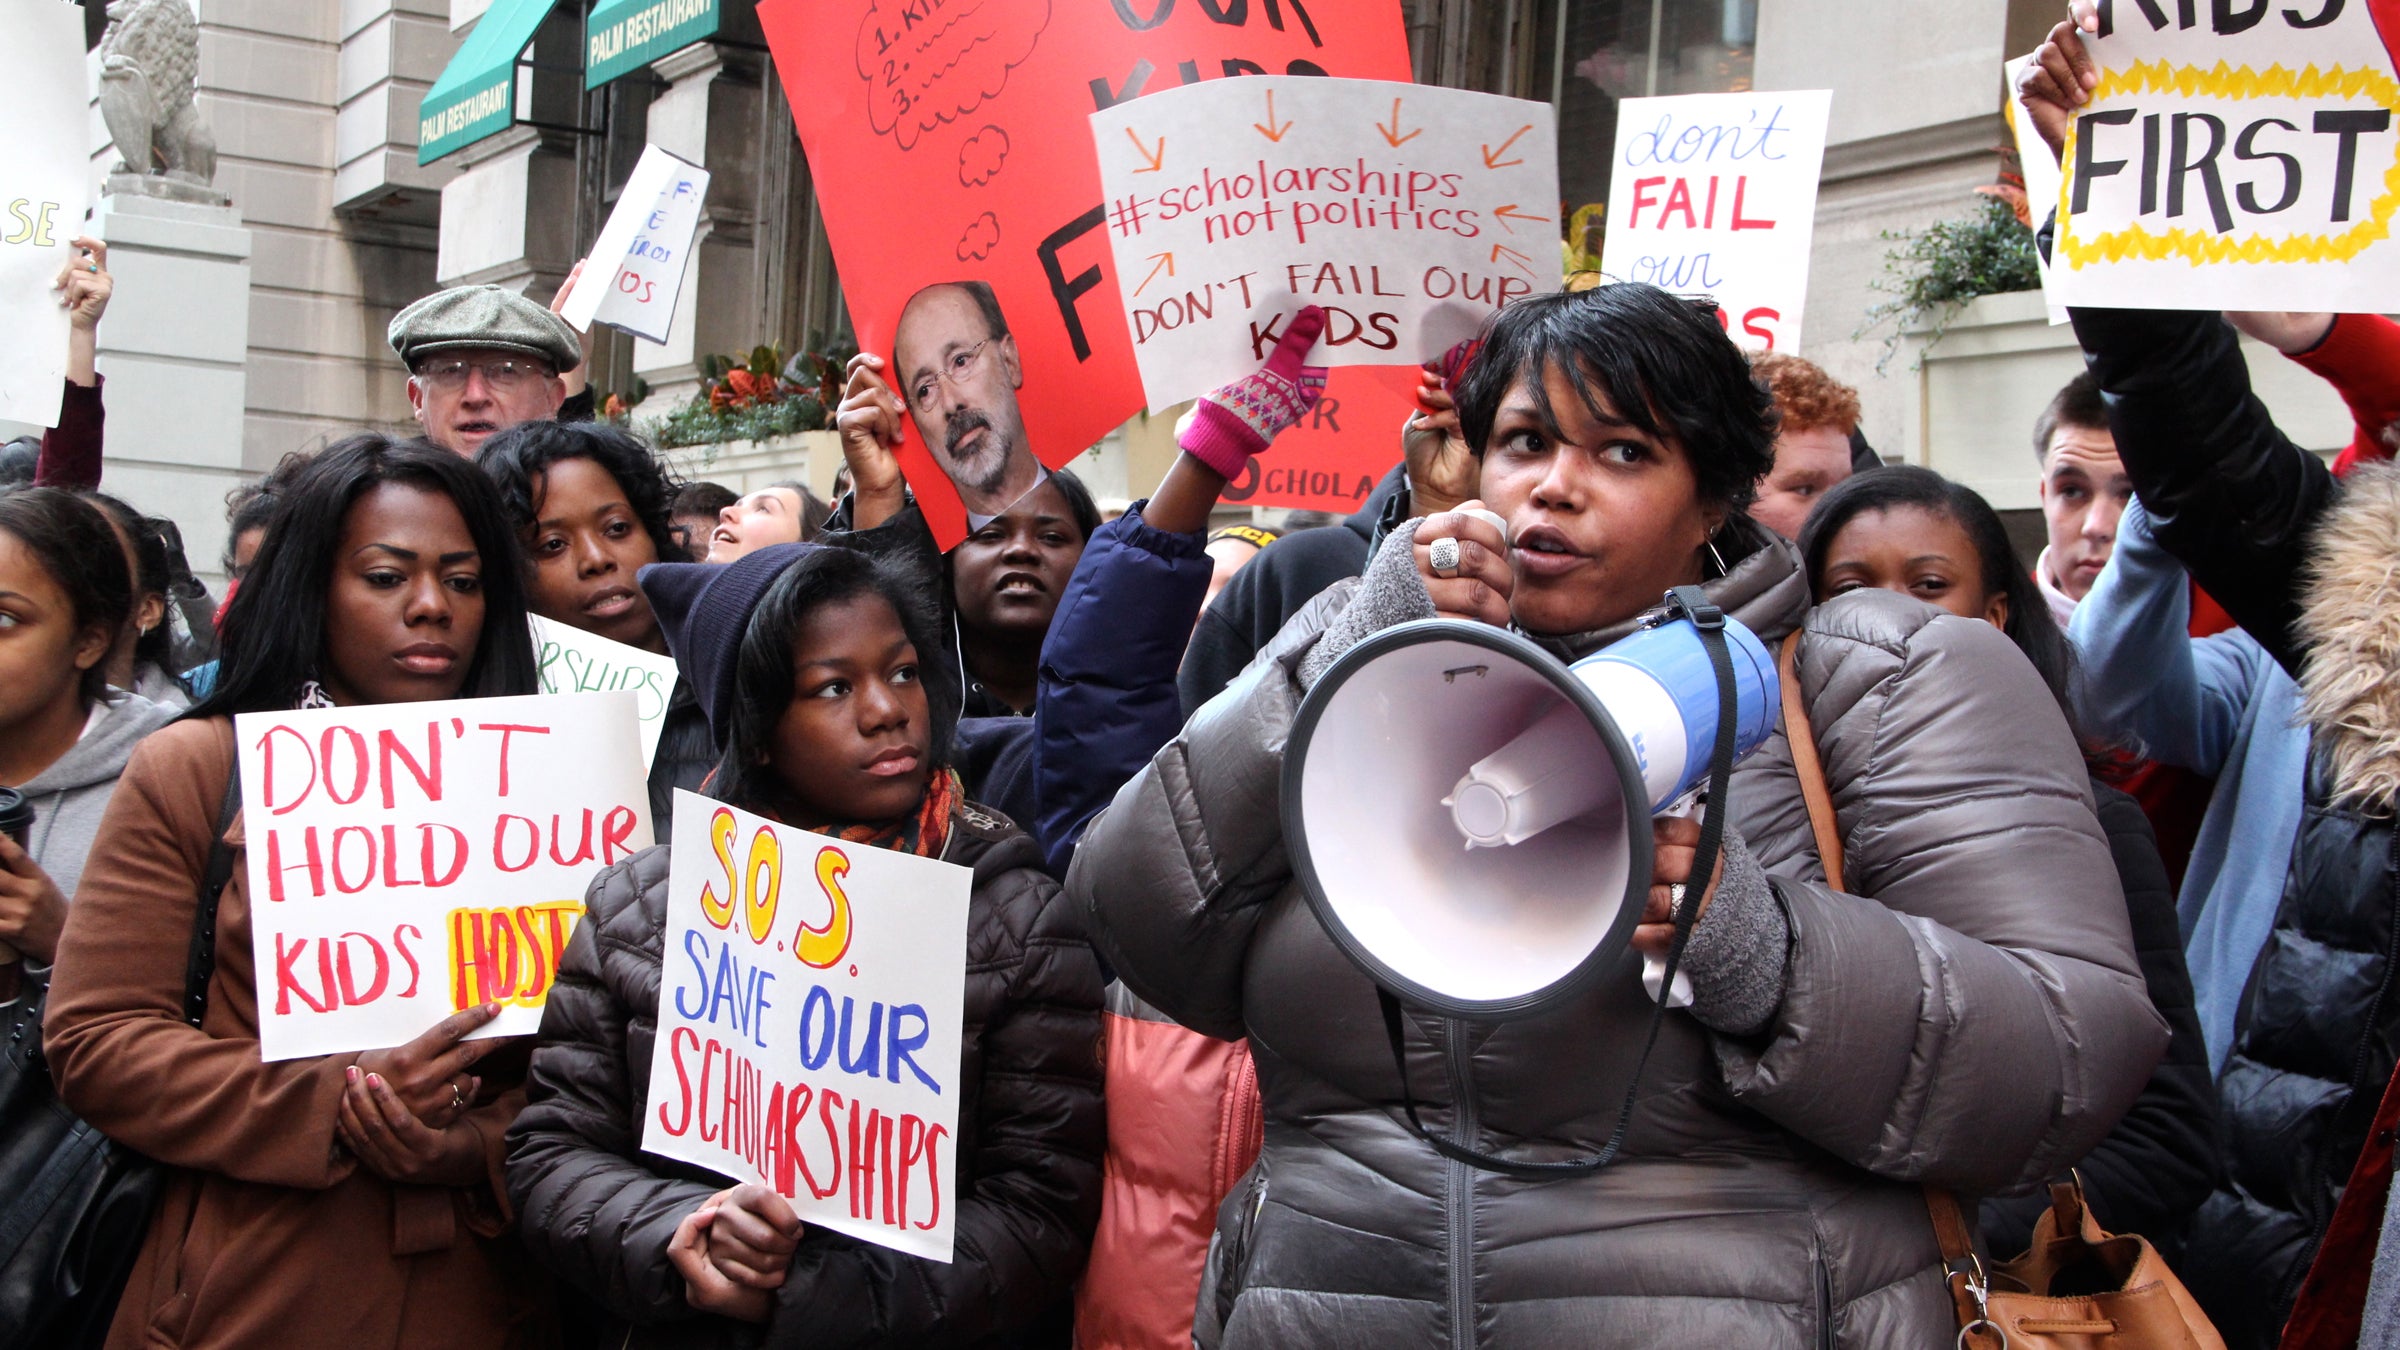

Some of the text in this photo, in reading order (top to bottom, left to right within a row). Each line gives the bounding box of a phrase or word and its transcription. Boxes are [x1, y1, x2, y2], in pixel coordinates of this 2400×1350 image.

[589, 22, 625, 68] PALM
[883, 59, 910, 88] 2.
[420, 80, 509, 148] PALM RESTAURANT
[892, 88, 920, 116] 3.
[1625, 105, 1791, 167] don't
[1108, 158, 1463, 237] #scholarships
[1629, 175, 1777, 231] FAIL
[2070, 107, 2391, 234] FIRST
[0, 198, 60, 247] SE
[1132, 271, 1258, 344] DON'T
[1285, 261, 1406, 297] FAIL
[1631, 252, 1723, 289] our
[1249, 306, 1399, 360] KDS
[256, 717, 551, 816] DON'T
[266, 804, 638, 902] HOLD OUR
[699, 806, 859, 977] S.O.S.
[274, 905, 588, 1016] KIDS HOST
[675, 928, 941, 1096] SAVE OUR
[658, 1026, 950, 1230] SCHOLARSHIPS
